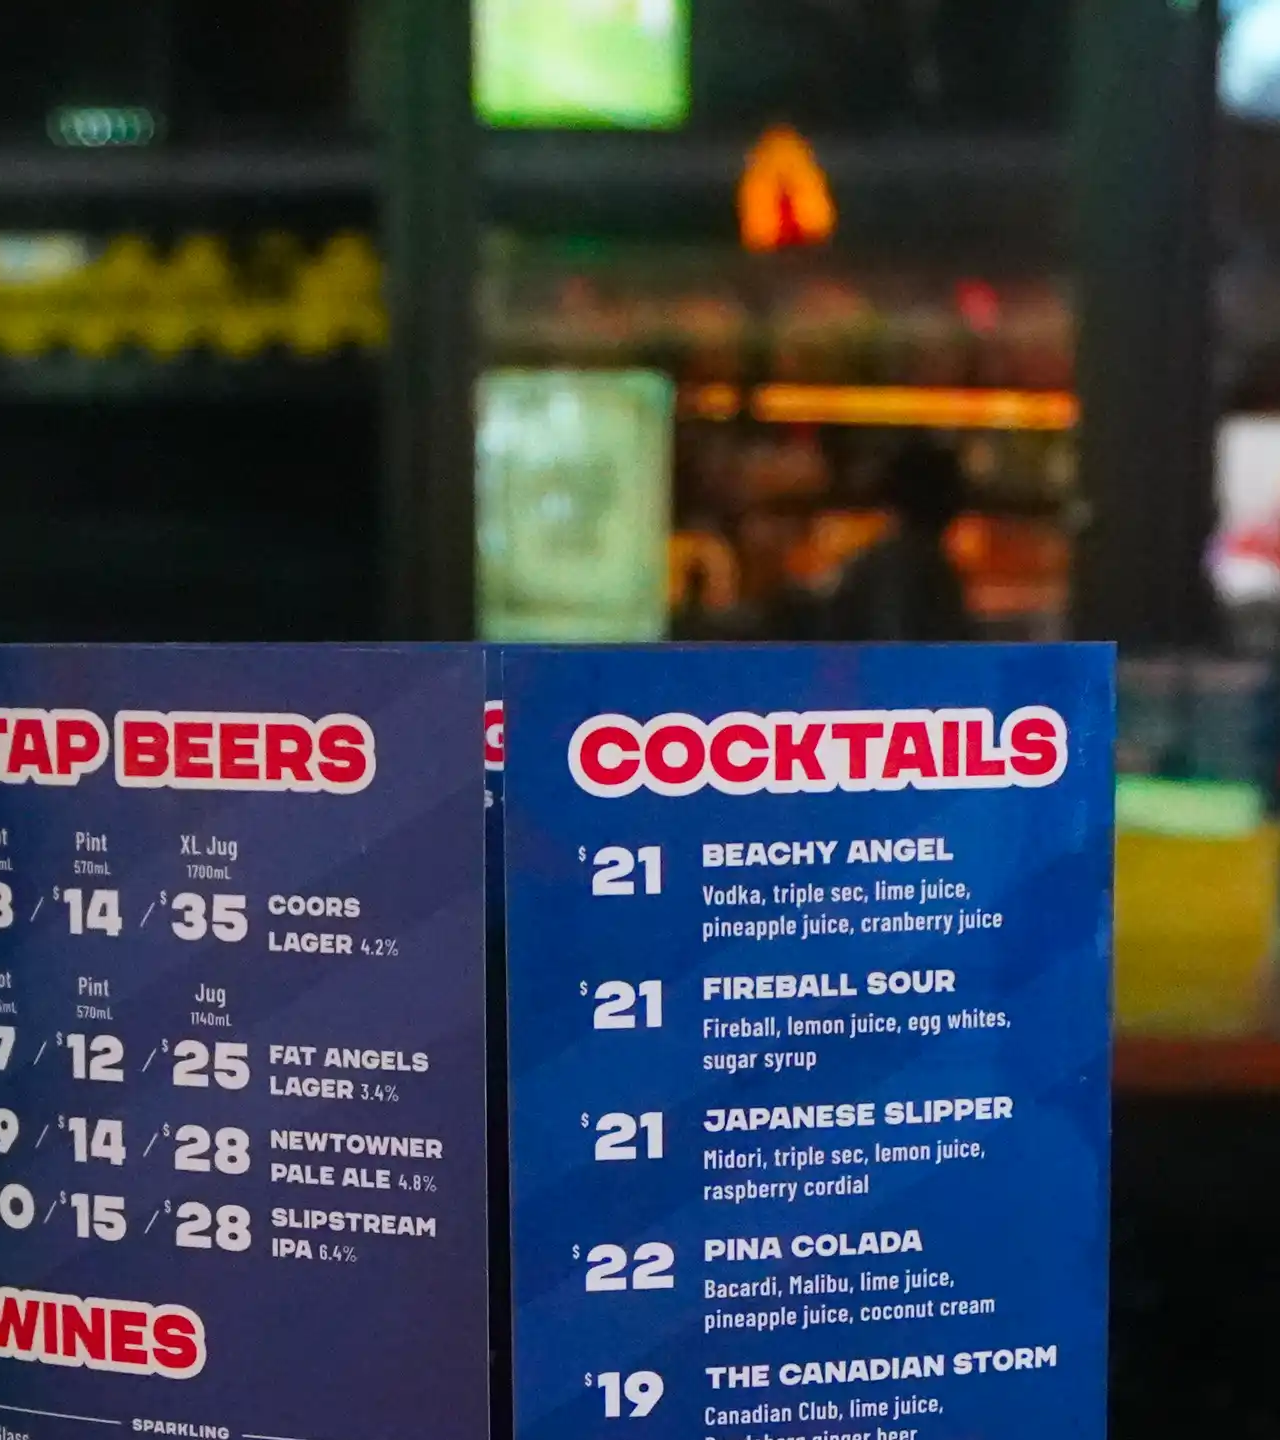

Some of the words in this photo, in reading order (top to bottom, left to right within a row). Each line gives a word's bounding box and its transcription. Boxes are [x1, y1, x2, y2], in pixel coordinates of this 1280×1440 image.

[119, 718, 370, 786] BEERS
[576, 714, 1062, 790] COCKTAILS
[76, 832, 107, 851] Pint
[181, 835, 201, 855] XL
[207, 836, 237, 861] Jug
[579, 846, 661, 895] $21
[703, 841, 838, 867] BEACHY
[847, 838, 953, 863] ANGEL
[703, 885, 765, 905] Vodka,
[773, 883, 824, 908] triple
[831, 887, 868, 903] sec,
[876, 880, 914, 900] lime
[920, 879, 970, 904] juice,
[54, 886, 122, 936] $14
[161, 891, 247, 942] $35
[268, 895, 360, 917] COORS
[703, 915, 796, 942] pineapple
[802, 913, 854, 939] juice,
[861, 912, 953, 934] cranberry
[958, 909, 1002, 934] juice
[269, 931, 352, 954] LAGER
[361, 939, 398, 956] 4.2%
[79, 977, 109, 997] Pint
[195, 984, 225, 1008] Jug
[580, 980, 662, 1029] $21
[704, 974, 857, 1000] FIREBALL
[867, 970, 955, 995] SOUR
[704, 1017, 780, 1038] Fireball,
[788, 1016, 844, 1035] lemon
[850, 1013, 901, 1038] juice,
[908, 1015, 940, 1035] egg
[948, 1008, 1010, 1028] whites,
[56, 1032, 123, 1082] $12
[162, 1039, 250, 1089] $25
[270, 1045, 316, 1065] FAT
[324, 1048, 428, 1071] ANGELS
[704, 1054, 757, 1074] sugar
[765, 1052, 816, 1072] syrup
[270, 1076, 353, 1099] LAGER
[361, 1084, 398, 1101] 3.4%
[582, 1112, 662, 1160] $21
[704, 1103, 875, 1132] JAPANESE
[885, 1097, 1013, 1124] SLIPPER
[58, 1116, 126, 1165] $14
[163, 1124, 250, 1174] $28
[271, 1130, 442, 1158] NEWTOWNER
[704, 1148, 767, 1169] Midori,
[774, 1146, 824, 1170] triple
[832, 1149, 868, 1165] sec,
[876, 1143, 930, 1162] lemon
[936, 1139, 984, 1164] juice,
[271, 1163, 334, 1185] PALE
[342, 1168, 390, 1188] ALE
[399, 1174, 436, 1192] 4.8%
[704, 1180, 797, 1204] raspberry
[804, 1174, 868, 1196] cordial
[60, 1191, 126, 1241] $15
[165, 1200, 251, 1251] $28
[272, 1208, 435, 1237] SLIPSTREAM
[272, 1238, 312, 1259] IPA
[320, 1244, 356, 1262] 6.4%
[573, 1242, 674, 1291] $22
[705, 1237, 782, 1261] PINA
[791, 1230, 922, 1257] COLADA
[705, 1277, 782, 1298] Bacardi,
[790, 1274, 853, 1294] Malibu,
[861, 1272, 899, 1291] lime
[904, 1268, 954, 1293] juice,
[705, 1307, 796, 1333] pineapple
[802, 1304, 853, 1329] juice,
[861, 1301, 933, 1321] coconut
[940, 1299, 994, 1316] cream
[585, 1371, 664, 1417] $19
[705, 1365, 769, 1388] THE
[779, 1355, 944, 1385] CANADIAN
[953, 1345, 1056, 1374] STORM
[705, 1404, 791, 1425] Canadian
[799, 1401, 843, 1420] Club,
[850, 1399, 888, 1418] lime
[893, 1395, 943, 1420] juice,
[133, 1418, 229, 1439] SPARKLING
